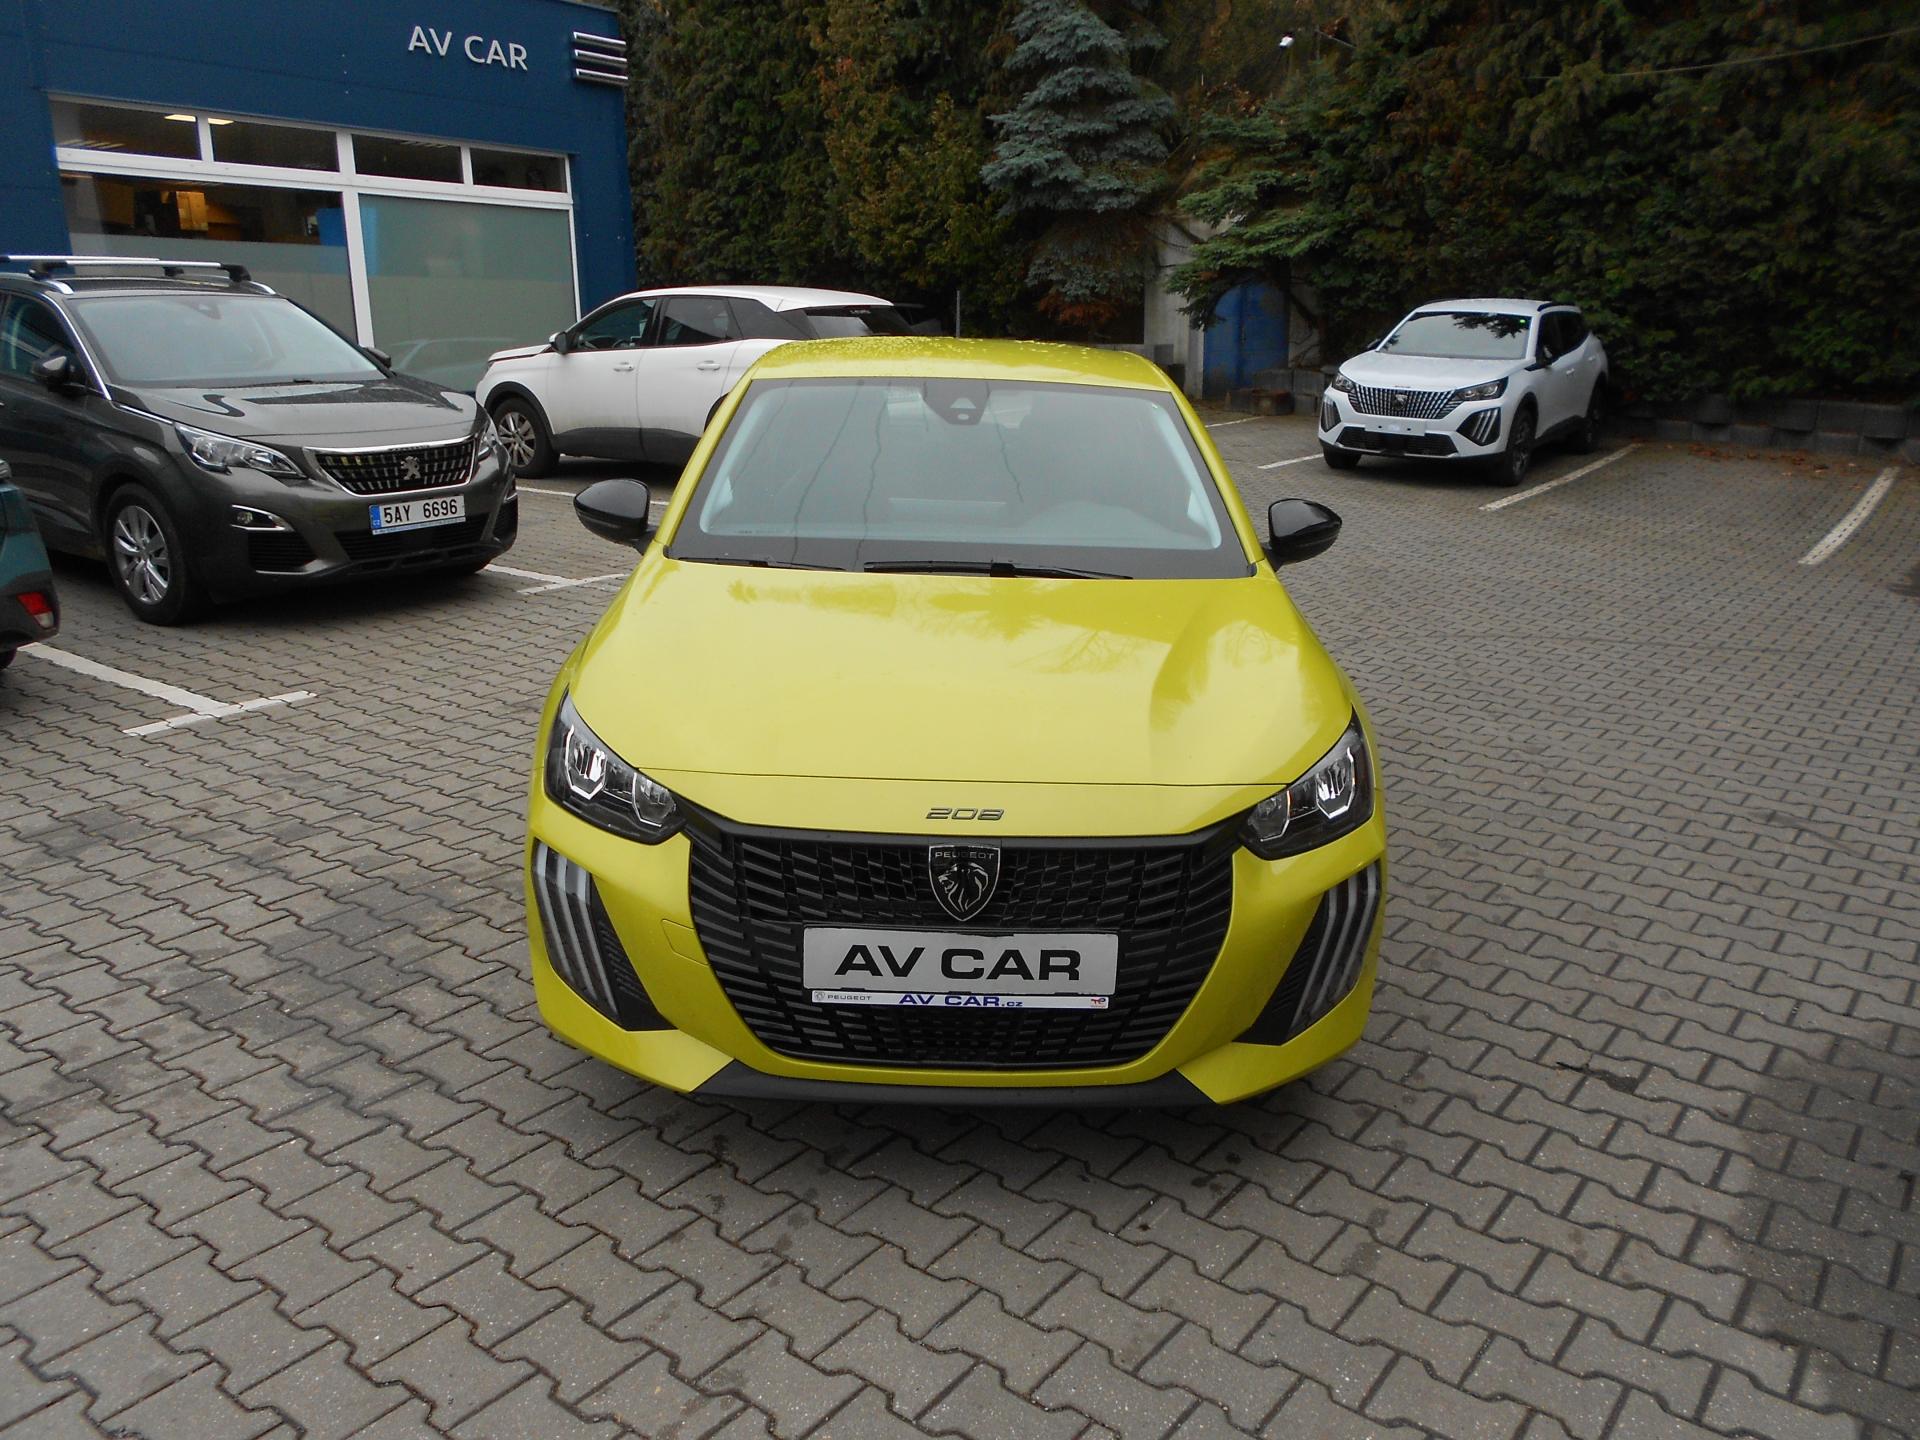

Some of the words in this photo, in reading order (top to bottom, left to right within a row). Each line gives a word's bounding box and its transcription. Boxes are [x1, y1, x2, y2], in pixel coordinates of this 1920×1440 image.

[408, 25, 452, 54] AV
[464, 35, 528, 71] CAR
[384, 505, 410, 523] 5AY
[423, 499, 457, 518] 6696
[926, 807, 1004, 821] 208
[835, 945, 926, 977] AV
[941, 949, 1081, 981] CAR
[898, 994, 935, 1006] AV
